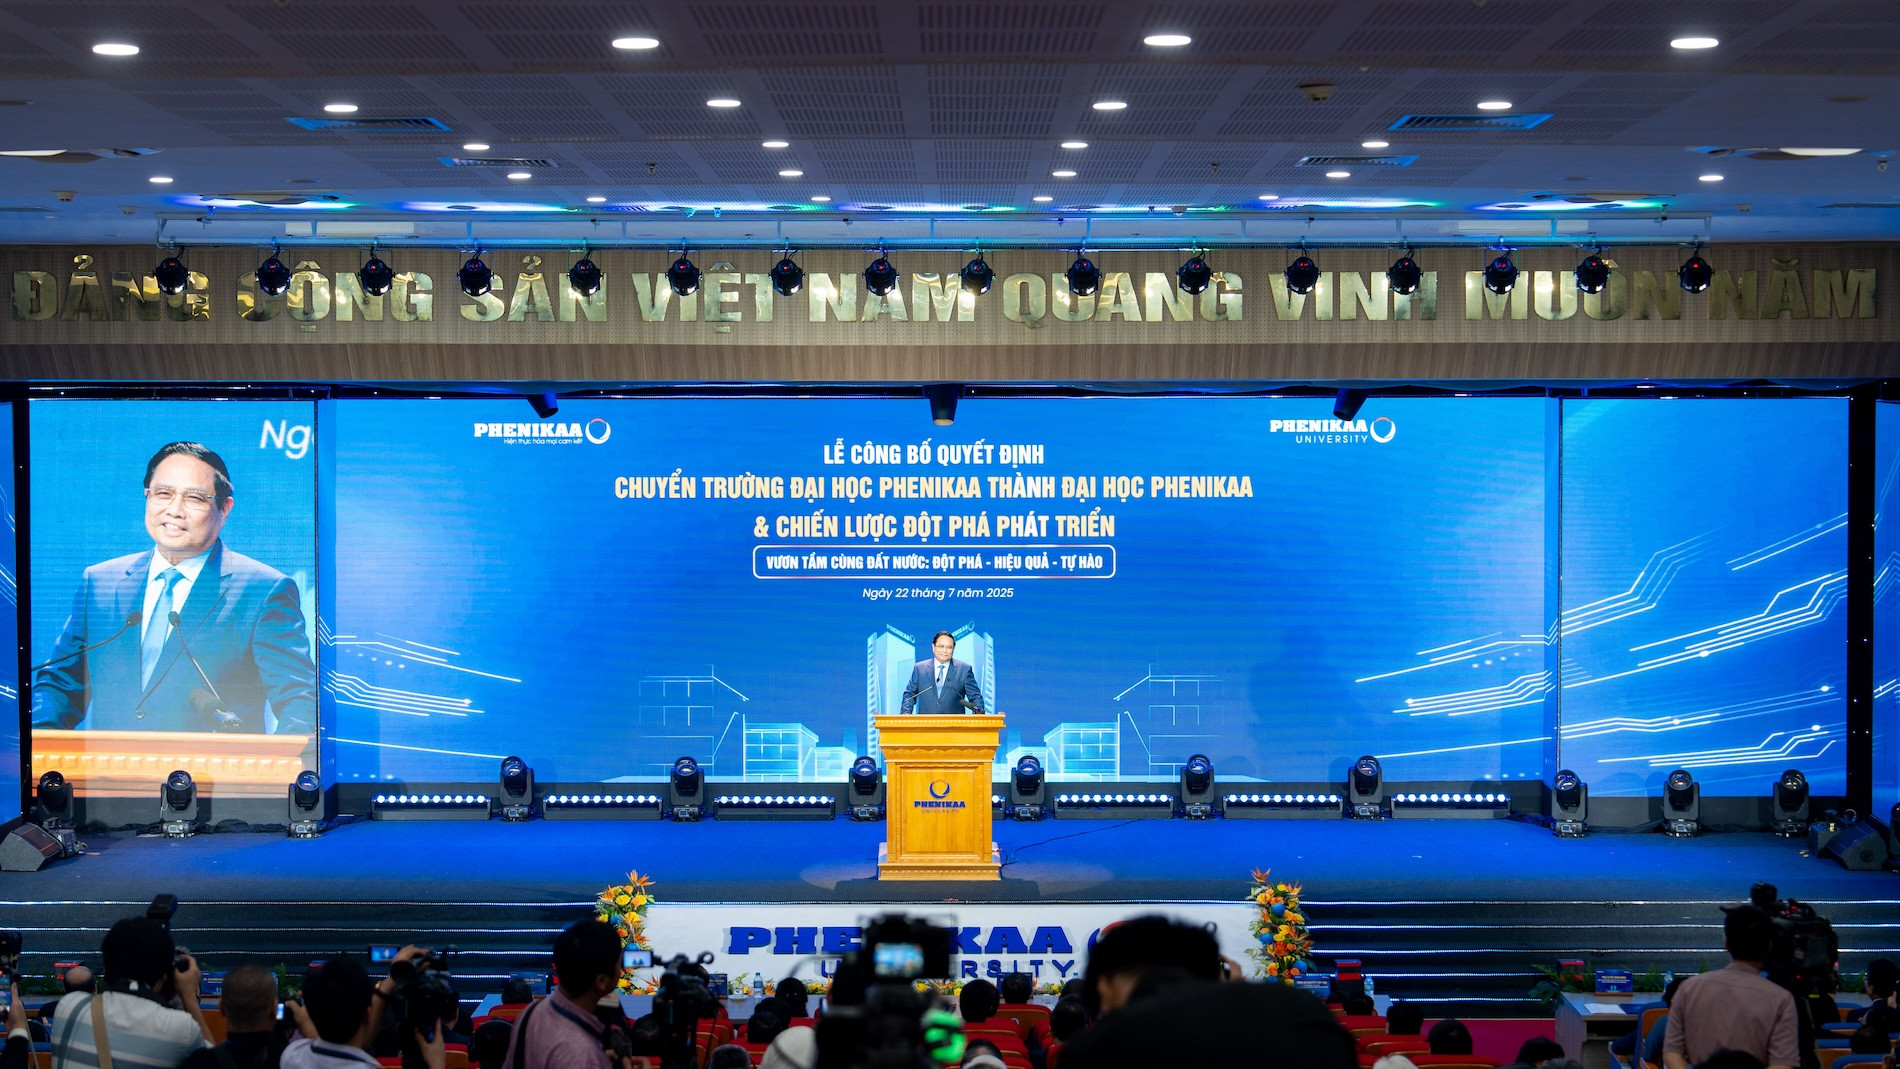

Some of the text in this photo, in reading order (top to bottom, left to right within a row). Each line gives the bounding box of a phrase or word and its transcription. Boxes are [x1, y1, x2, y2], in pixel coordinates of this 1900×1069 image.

[809, 273, 975, 322] NAM
[1003, 272, 1243, 329] QUANG
[1268, 271, 1437, 321] VINH
[1709, 258, 1877, 320] NĂM
[474, 422, 583, 437] PHENIKAA
[1269, 419, 1368, 432] PHENIKAA
[259, 419, 315, 459] Ng
[1295, 434, 1368, 444] UNIVERSITY
[823, 437, 1044, 468] LỄ CÔNG BỐ QUYẾT ĐỊNH
[614, 467, 1253, 504] CHUYỂN TRƯỜNG ĐẠI HỌC PHENIKAA THÀNH ĐẠI HỌC PHENIKAA
[753, 506, 1115, 543] & CHIẾN LƯỢC ĐỘT PHÁ PHÁT TRIỂN
[766, 554, 799, 570] VƯƠN
[831, 553, 864, 570] CÙNG
[866, 551, 890, 570] ĐẤT
[892, 553, 930, 570] NƯỚC:
[932, 553, 955, 572] ĐỘT
[958, 553, 983, 570] PHÁ
[994, 553, 1022, 572] HIỆU
[1025, 551, 1050, 571] QUẢ
[1061, 554, 1077, 572] TỰ
[1079, 553, 1103, 570] HÀO
[862, 588, 1014, 601] Ngày 22 tháng 7 năm 2025
[914, 800, 966, 808] PHENIKAA
[729, 926, 1073, 954] PHEKAA
[821, 959, 1075, 978] URSITY
